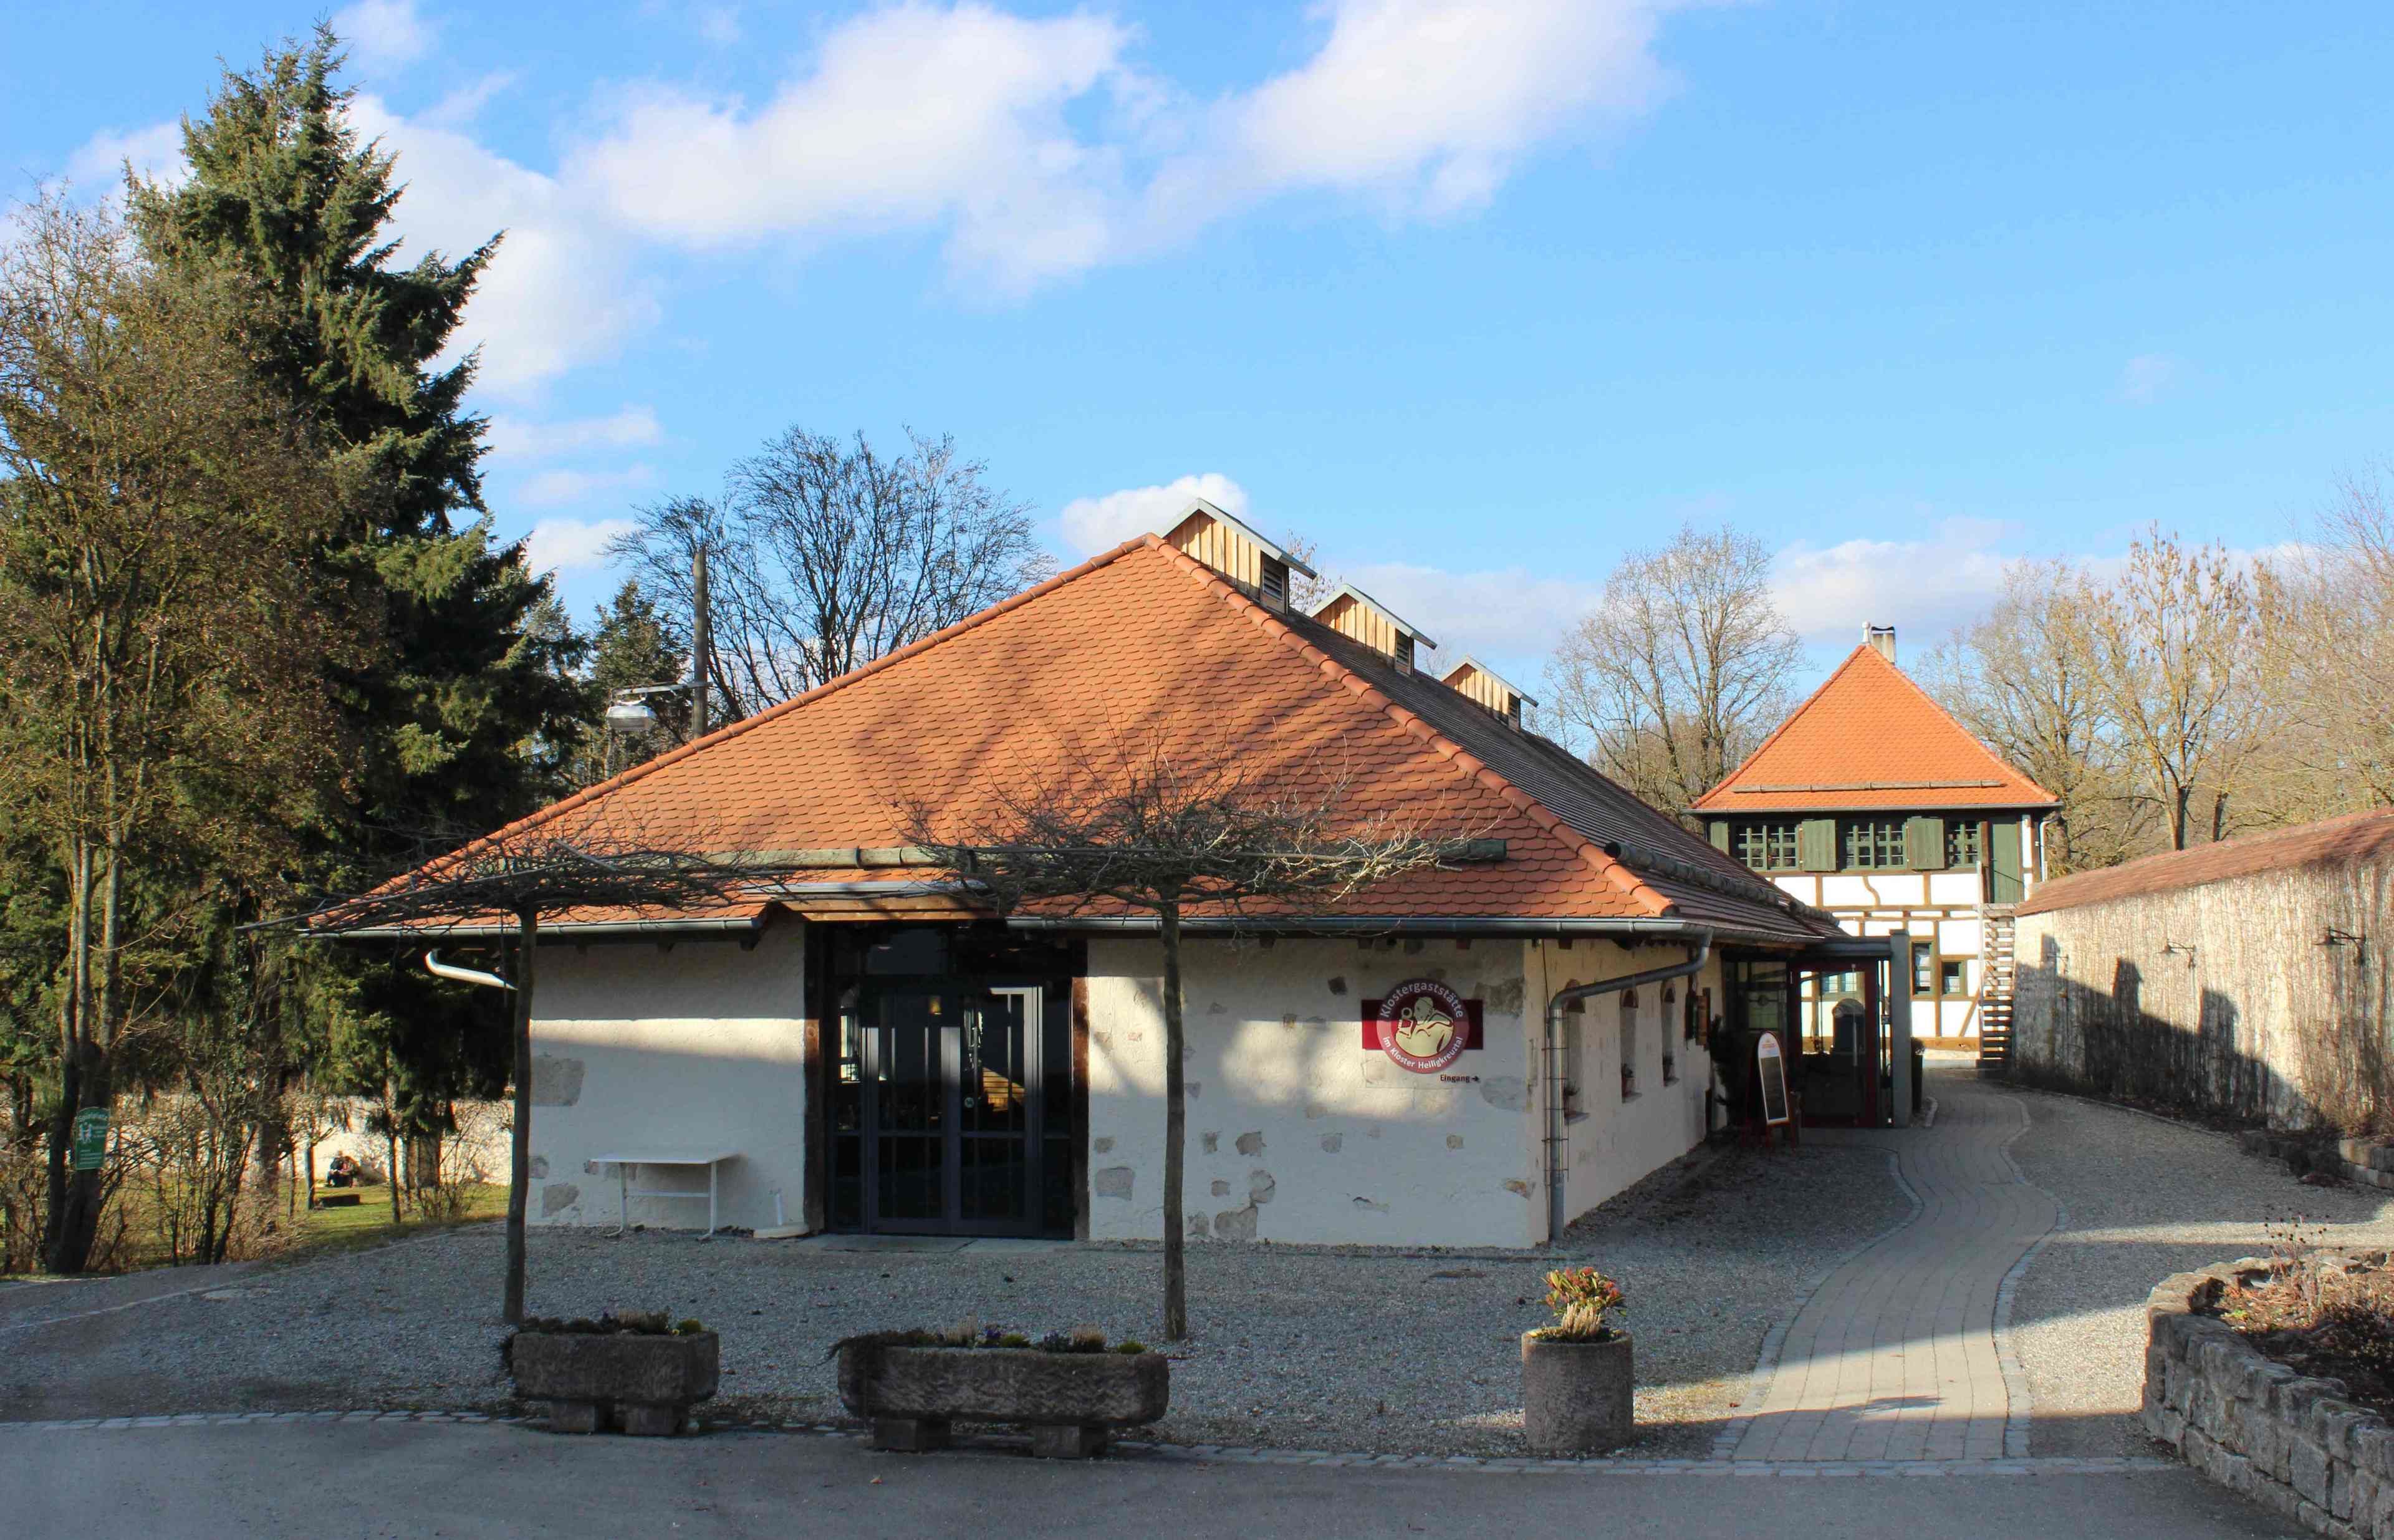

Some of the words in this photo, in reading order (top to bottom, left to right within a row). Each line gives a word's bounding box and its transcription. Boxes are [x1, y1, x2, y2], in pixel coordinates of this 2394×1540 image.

[1380, 981, 1464, 1018] Klostergaststätte
[1382, 1036, 1390, 1047] im
[1390, 1047, 1415, 1067] Kloster
[1418, 1037, 1463, 1069] Heiligkreuztal
[1440, 1074, 1470, 1083] Eingang
